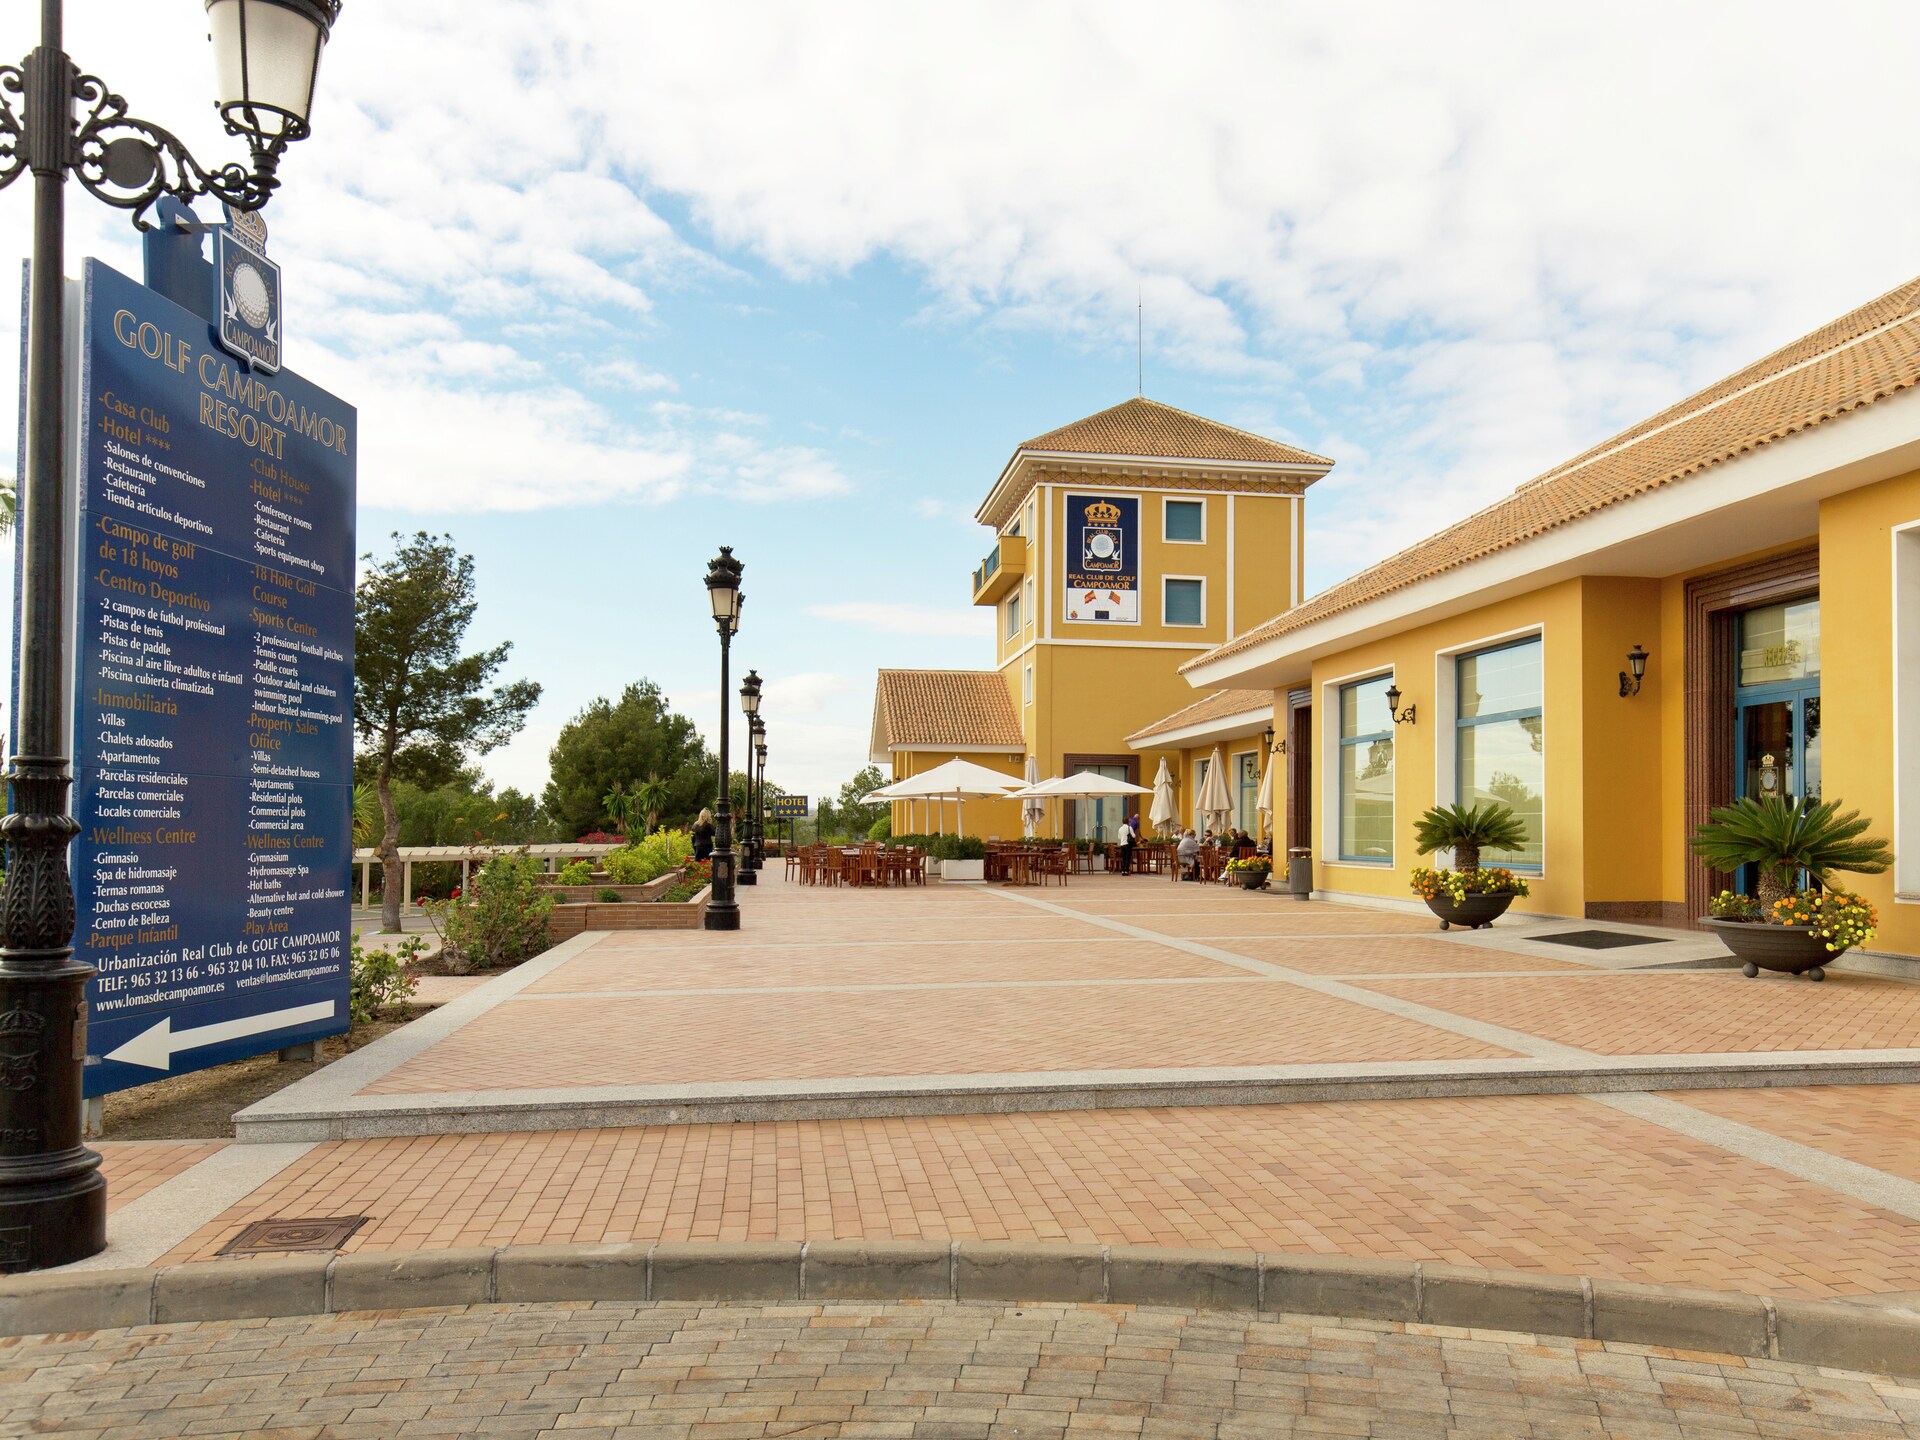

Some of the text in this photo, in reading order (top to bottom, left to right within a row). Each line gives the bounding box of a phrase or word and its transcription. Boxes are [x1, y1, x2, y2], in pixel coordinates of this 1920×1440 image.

[225, 320, 276, 366] CAMPOAMOR
[113, 309, 347, 455] GOLF CAMPOAMOR
[140, 407, 169, 433] Club
[200, 391, 286, 460] RESORT
[142, 455, 152, 467] de
[154, 461, 205, 488] convenciones
[280, 469, 310, 494] House
[137, 502, 172, 521] artículos
[174, 512, 213, 534] deportivos
[294, 517, 312, 530] rooms
[153, 533, 168, 551] de
[172, 542, 195, 560] golf
[100, 541, 178, 579] de 18 hoyos
[278, 552, 310, 568] equipment
[311, 560, 324, 575] shop
[1086, 560, 1119, 568] CAMPOAMOR
[270, 570, 316, 596] Hole Golf
[1074, 580, 1130, 589] CAMPOAMOR
[150, 582, 210, 612] Deportivo
[253, 586, 287, 608] Course
[113, 602, 225, 635] campos de futbol profesional
[131, 621, 141, 633] de
[144, 625, 163, 637] tenis
[287, 617, 317, 637] Centre
[130, 637, 140, 649] de
[143, 641, 171, 655] paddle
[262, 636, 343, 661] professional football pitches
[278, 652, 297, 663] courts
[136, 656, 143, 667] al
[146, 658, 161, 670] aire
[164, 660, 181, 674] libre
[184, 665, 210, 679] adultos
[218, 670, 243, 684] infantil
[279, 665, 298, 677] courts
[135, 673, 169, 688] cubierta
[172, 678, 214, 695] climatizada
[284, 679, 300, 690] adult
[301, 683, 312, 692] and
[314, 685, 336, 697] children
[254, 688, 302, 704] swimming pool
[278, 704, 298, 716] heated
[296, 720, 318, 735] Sales
[136, 735, 173, 749] adosados
[250, 733, 281, 750] Office
[138, 772, 188, 785] residenciales
[300, 767, 320, 778] houses
[137, 790, 184, 801] comerciales
[288, 793, 303, 805] plots
[777, 798, 806, 806] HOTEL
[133, 807, 180, 818] comerciales
[291, 807, 306, 819] plots
[291, 822, 304, 830] area
[156, 827, 196, 844] Centre
[294, 834, 324, 848] Centre
[116, 868, 126, 879] de
[129, 866, 177, 880] hidromasaje
[298, 865, 309, 876] Spa
[130, 885, 164, 894] romanas
[264, 879, 281, 889] baths
[287, 891, 297, 902] hot
[299, 890, 310, 900] and
[312, 889, 324, 899] cold
[325, 888, 345, 898] shower
[131, 900, 170, 910] escocesas
[274, 906, 294, 915] centre
[128, 915, 138, 926] de
[141, 913, 169, 925] Belleza
[267, 921, 288, 933] Area
[138, 924, 178, 943] Infantil
[98, 931, 340, 972] Urbanización Real Club de GOLF CAMPOAMOR
[97, 976, 127, 992] TELF:
[131, 973, 151, 988] 965
[155, 970, 167, 984] 32
[171, 968, 183, 981] 13
[187, 966, 198, 979] 66
[208, 963, 225, 976] 965
[228, 960, 238, 974] 32
[242, 959, 252, 971] 04
[272, 954, 289, 967] FAX:
[292, 952, 306, 964] 965
[309, 950, 317, 961] 32
[320, 948, 328, 959] 05
[331, 947, 339, 958] 06
[97, 964, 339, 1011] www.lomasdecampoamor.es ventas@lomasdecampoamor.es
